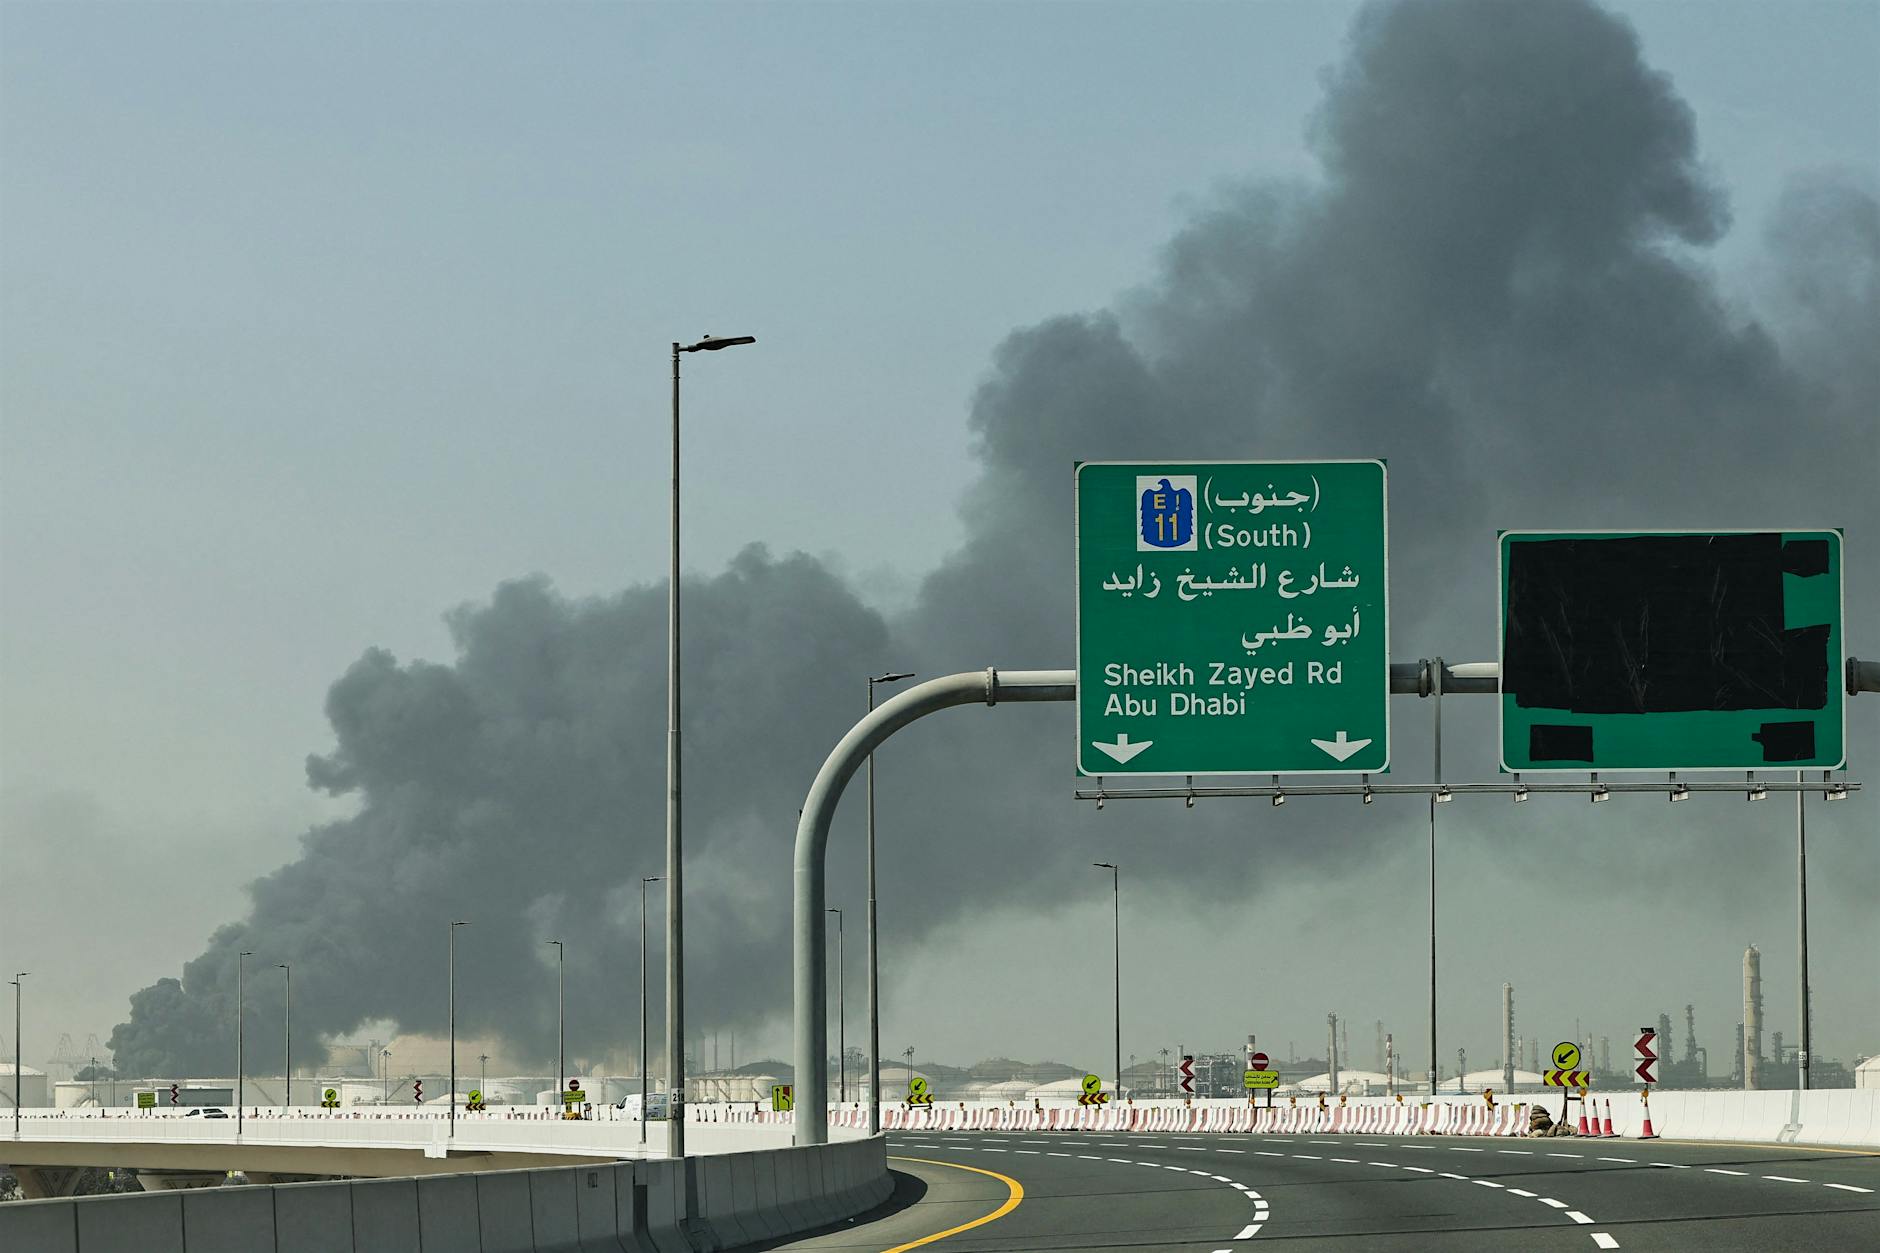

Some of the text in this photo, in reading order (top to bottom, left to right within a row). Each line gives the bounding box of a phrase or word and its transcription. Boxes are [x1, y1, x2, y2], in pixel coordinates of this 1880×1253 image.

[1153, 493, 1167, 510] E
[1204, 475, 1320, 514] (جنوب)
[1155, 513, 1178, 541] 11
[1204, 521, 1311, 549] (South)
[1102, 562, 1360, 601] شارع الشيخ زايد
[1241, 605, 1360, 656] أبو ظبي
[1103, 660, 1342, 690] Sheikh Zayed Rd
[1103, 691, 1245, 717] Abu Dhabi
